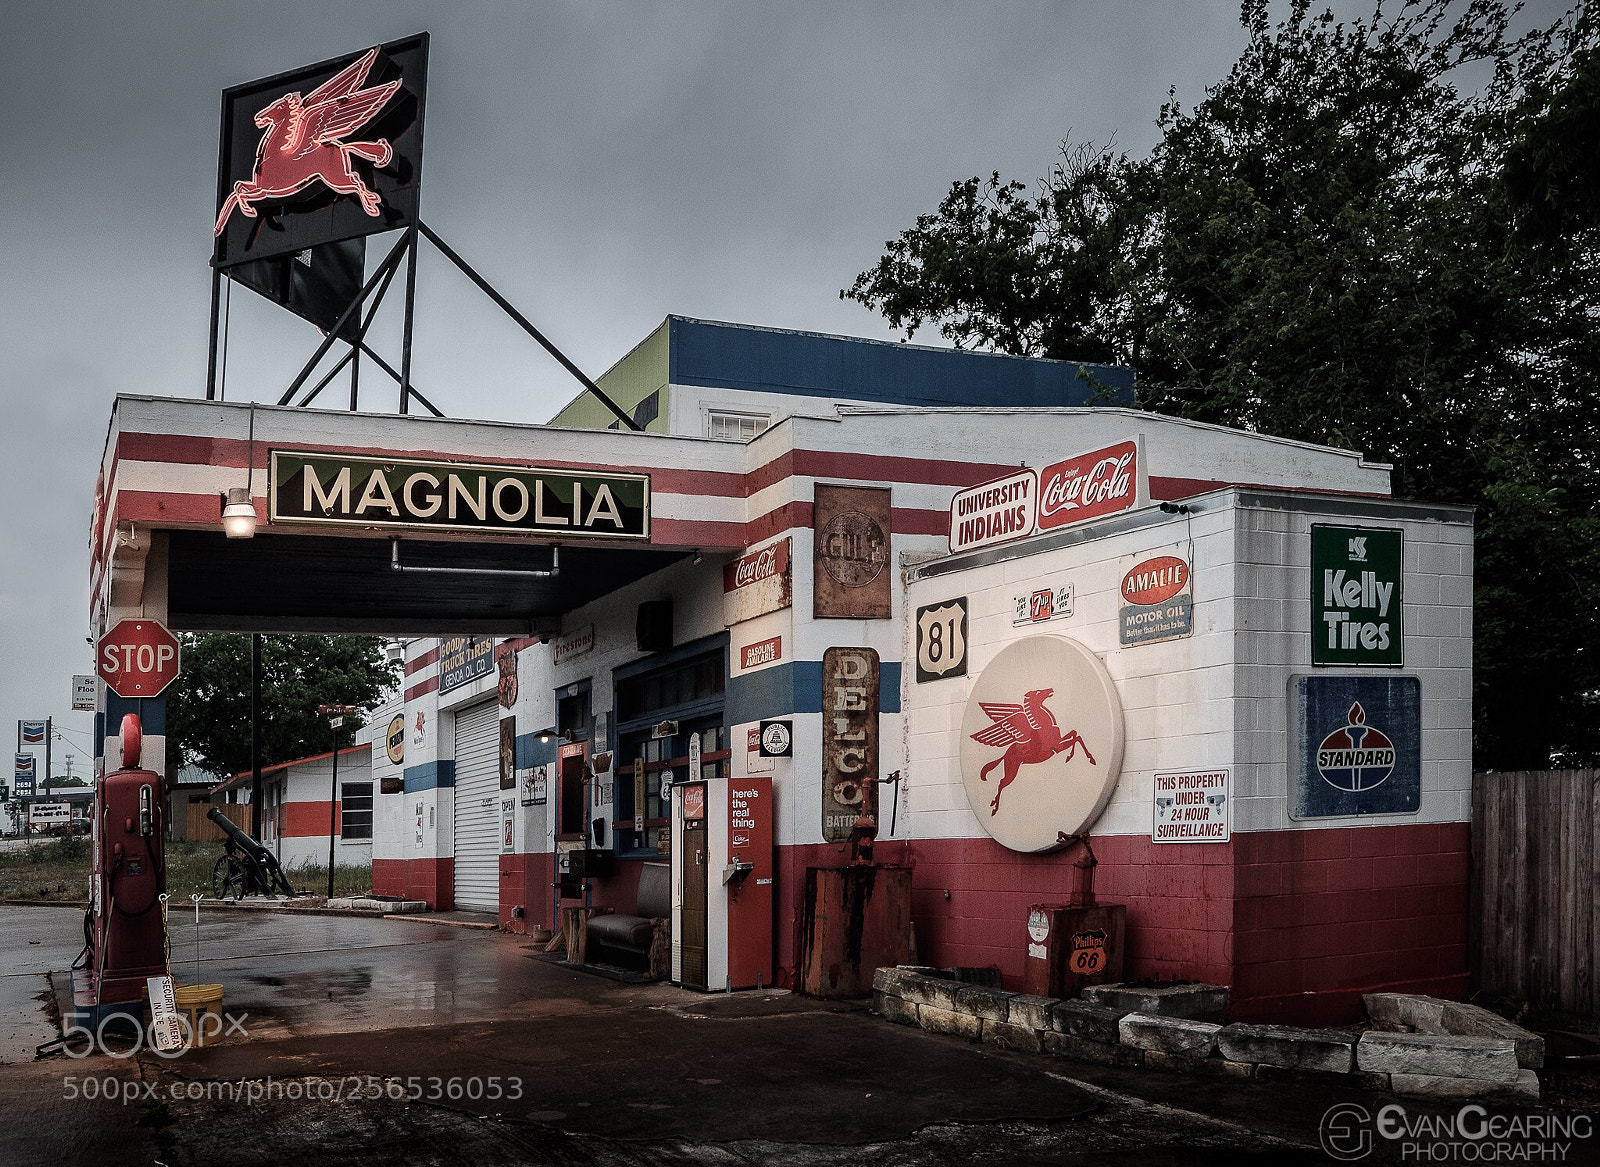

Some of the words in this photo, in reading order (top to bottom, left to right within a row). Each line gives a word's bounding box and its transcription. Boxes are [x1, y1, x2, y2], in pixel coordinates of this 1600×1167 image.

[1041, 450, 1135, 517] Coca-Cola
[303, 464, 624, 529] MAGNOLIA
[958, 478, 1030, 517] UNIVERSITY
[958, 505, 1027, 546] INDIANS
[735, 546, 777, 588] Coca-Cola
[1125, 564, 1183, 595] AMALIE
[1323, 569, 1394, 618] Kelly
[1126, 609, 1164, 627] MOTOR
[1166, 605, 1185, 618] OIL
[928, 617, 956, 663] 81
[1323, 611, 1390, 651] Tires
[555, 632, 592, 659] Firestone
[747, 641, 775, 659] GASOLINE
[102, 644, 175, 673] STOP
[441, 651, 466, 675] TRUCK
[466, 639, 492, 662] TIRES
[745, 651, 775, 668] AVAILABLE
[445, 669, 464, 687] GENOA
[465, 664, 475, 678] OIL
[833, 655, 869, 805] DELCO
[1318, 748, 1395, 768] STANDARD
[1157, 776, 1176, 790] THIS
[1178, 773, 1226, 789] PROPERTY
[732, 788, 759, 799] here's
[732, 799, 748, 808] the
[1175, 791, 1205, 806] UNDER
[501, 797, 515, 812] OPEN
[732, 808, 750, 818] real
[1170, 808, 1183, 821] 24
[1184, 807, 1210, 821] HOUR
[732, 818, 755, 829] thing
[826, 813, 875, 829] BATTERS
[1157, 823, 1224, 838] SURVEILLANCE
[1073, 935, 1103, 950] Phillips
[1076, 951, 1100, 969] 66
[153, 1002, 162, 1010] IN
[161, 980, 175, 1014] SECURITY
[154, 1012, 165, 1026] USE
[167, 1015, 180, 1045] CAMERA
